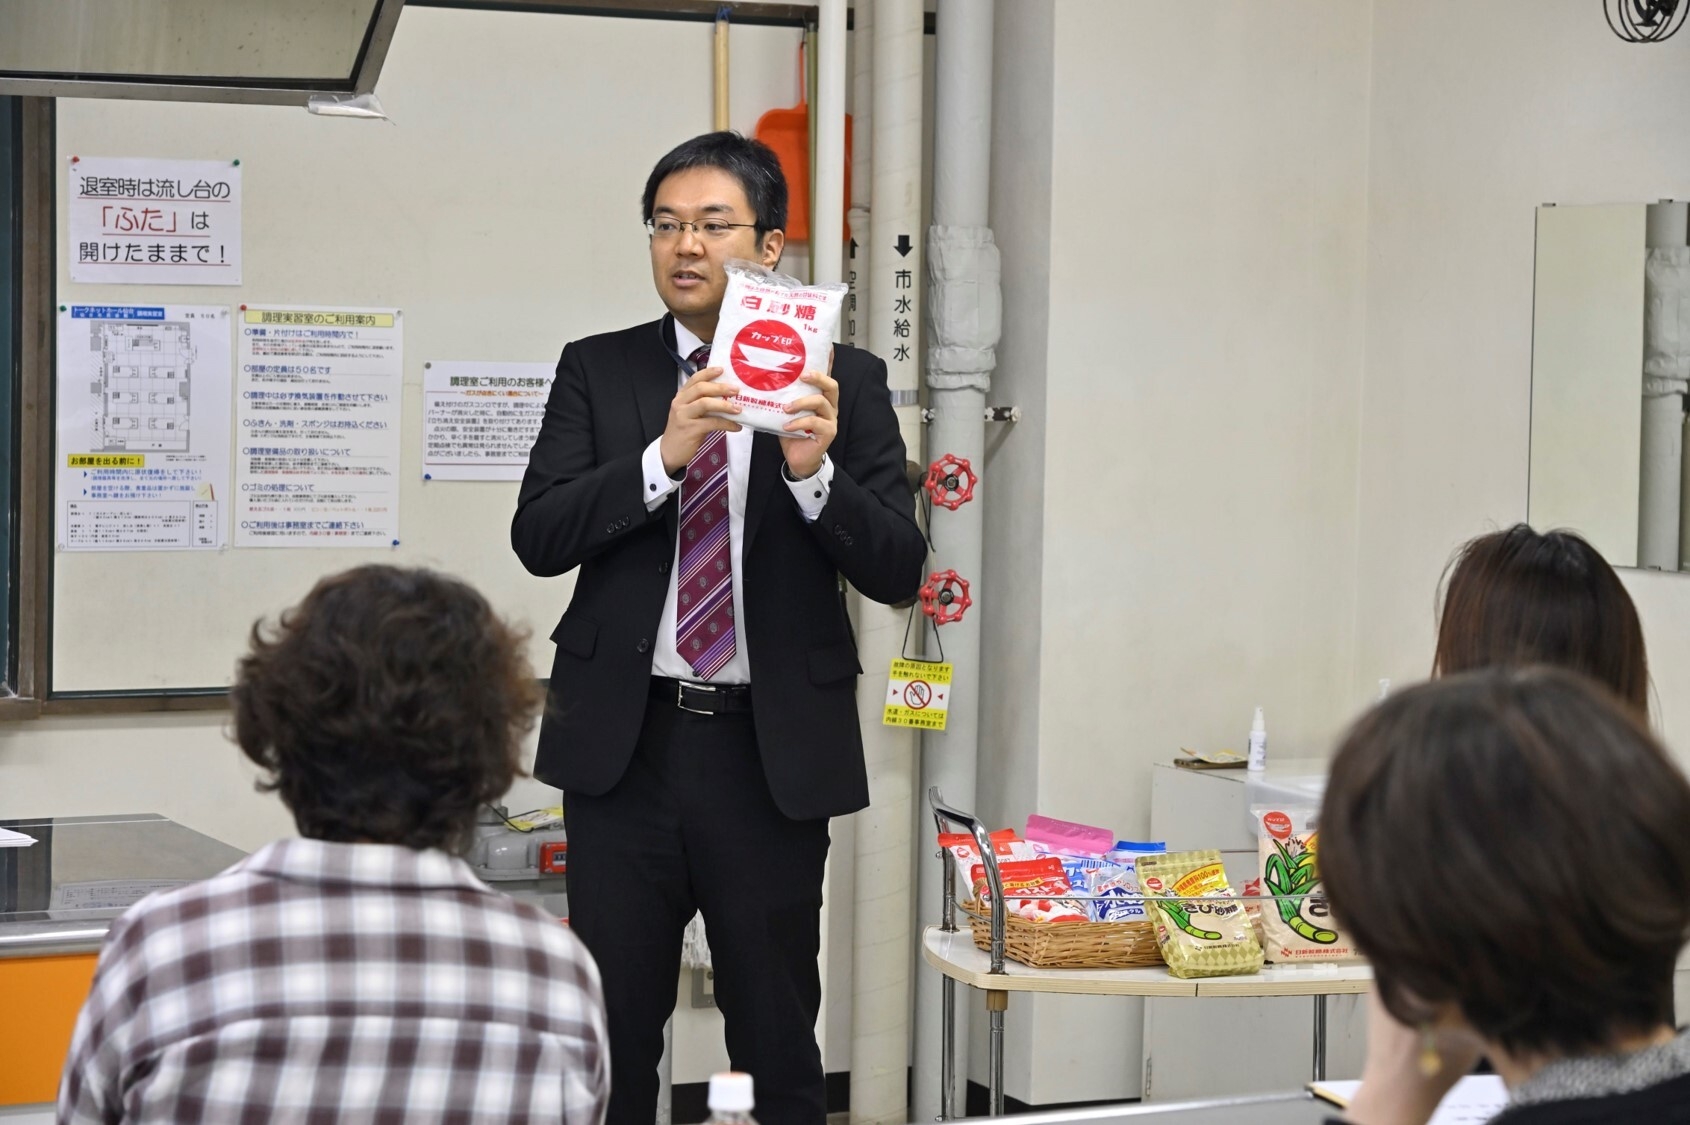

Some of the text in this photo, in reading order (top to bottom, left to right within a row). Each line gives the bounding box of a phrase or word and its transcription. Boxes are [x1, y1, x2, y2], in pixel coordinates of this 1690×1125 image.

[80, 177, 230, 198] 退室時は流し台の
[741, 295, 817, 321] 白砂糖
[893, 268, 912, 362] 市水給水
[262, 312, 376, 325] 調理実習室のご利用案内
[803, 323, 818, 333] 1kg
[751, 331, 793, 346] カップ印
[735, 394, 787, 410] 日新製糖株式
